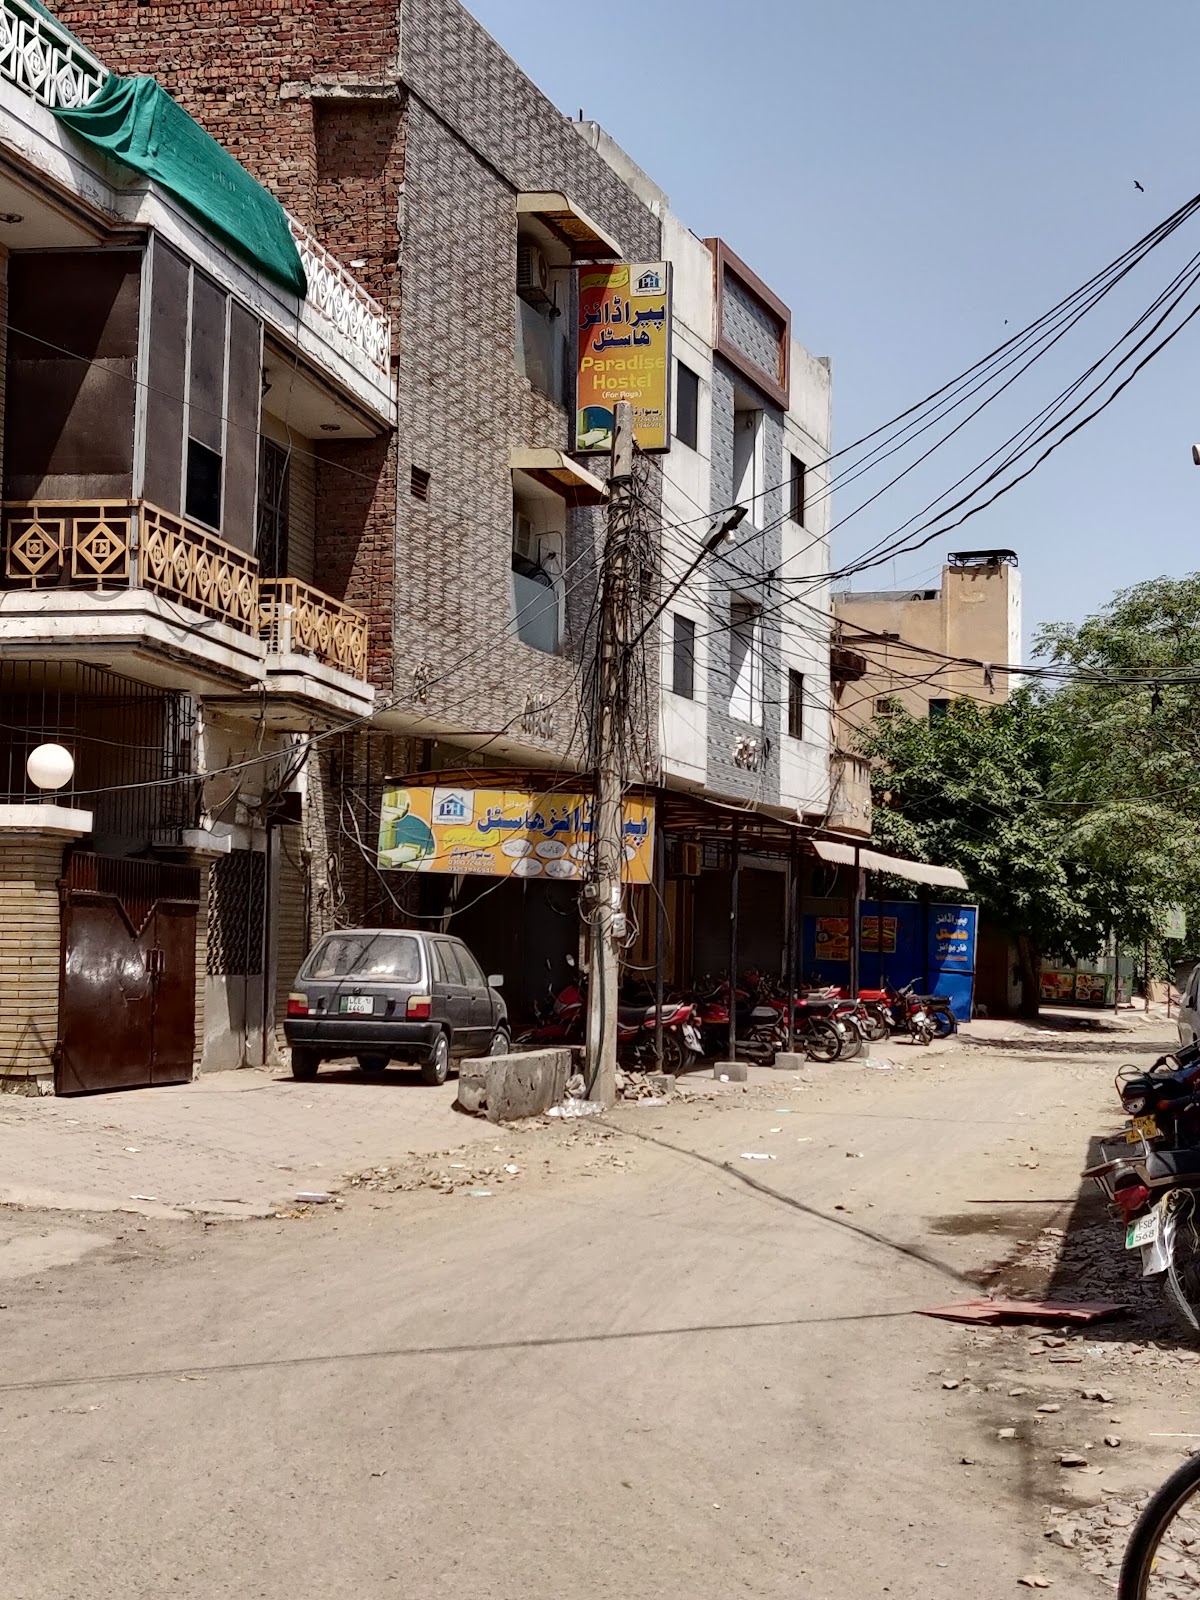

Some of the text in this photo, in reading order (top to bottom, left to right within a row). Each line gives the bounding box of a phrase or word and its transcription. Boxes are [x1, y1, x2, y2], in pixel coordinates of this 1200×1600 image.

[642, 277, 657, 288] PH
[580, 355, 666, 373] Paradise
[593, 373, 651, 389] Hostel
[602, 391, 619, 399] (For
[443, 803, 462, 815] PH
